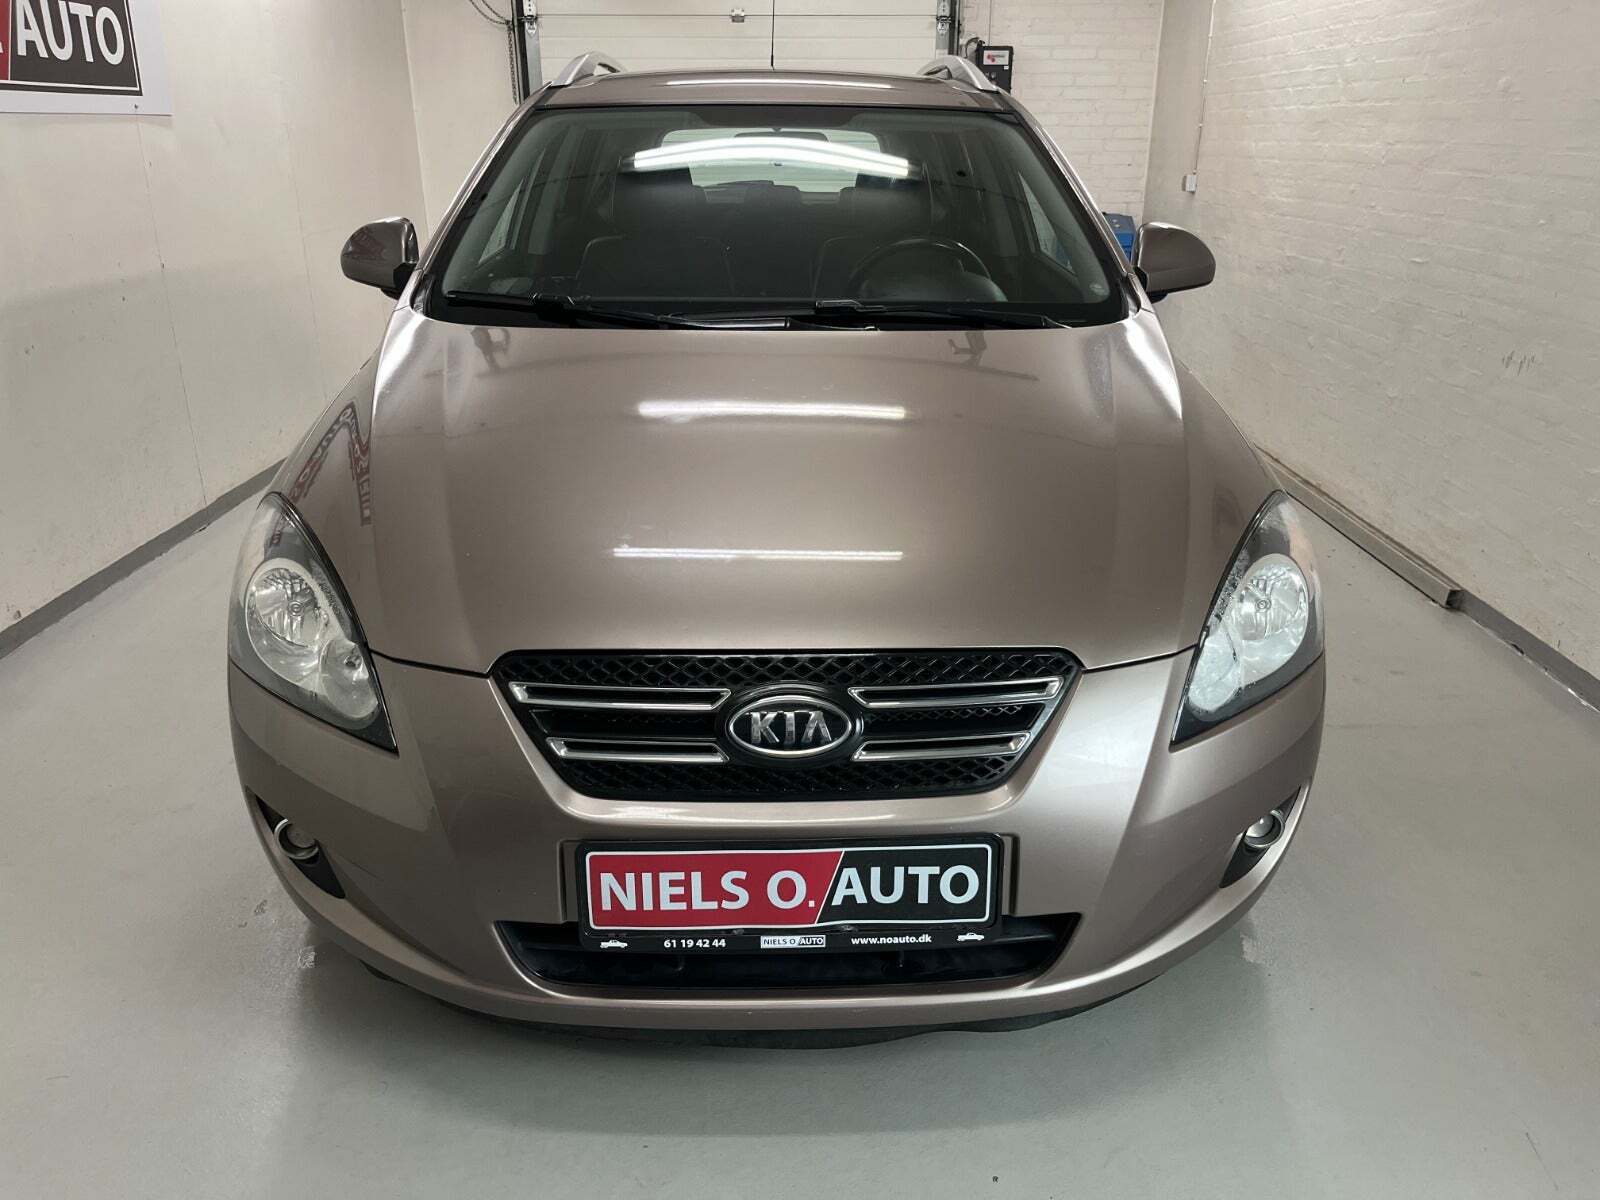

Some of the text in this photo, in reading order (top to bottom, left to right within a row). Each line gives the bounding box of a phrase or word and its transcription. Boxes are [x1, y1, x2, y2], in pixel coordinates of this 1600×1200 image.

[16, 0, 125, 65] AUTO
[750, 711, 832, 744] KIA
[600, 865, 979, 911] NIELS O. AUTO
[663, 938, 726, 948] 61 19 42 44
[800, 937, 824, 945] AUTO
[851, 934, 932, 945] www.noauto.dk
